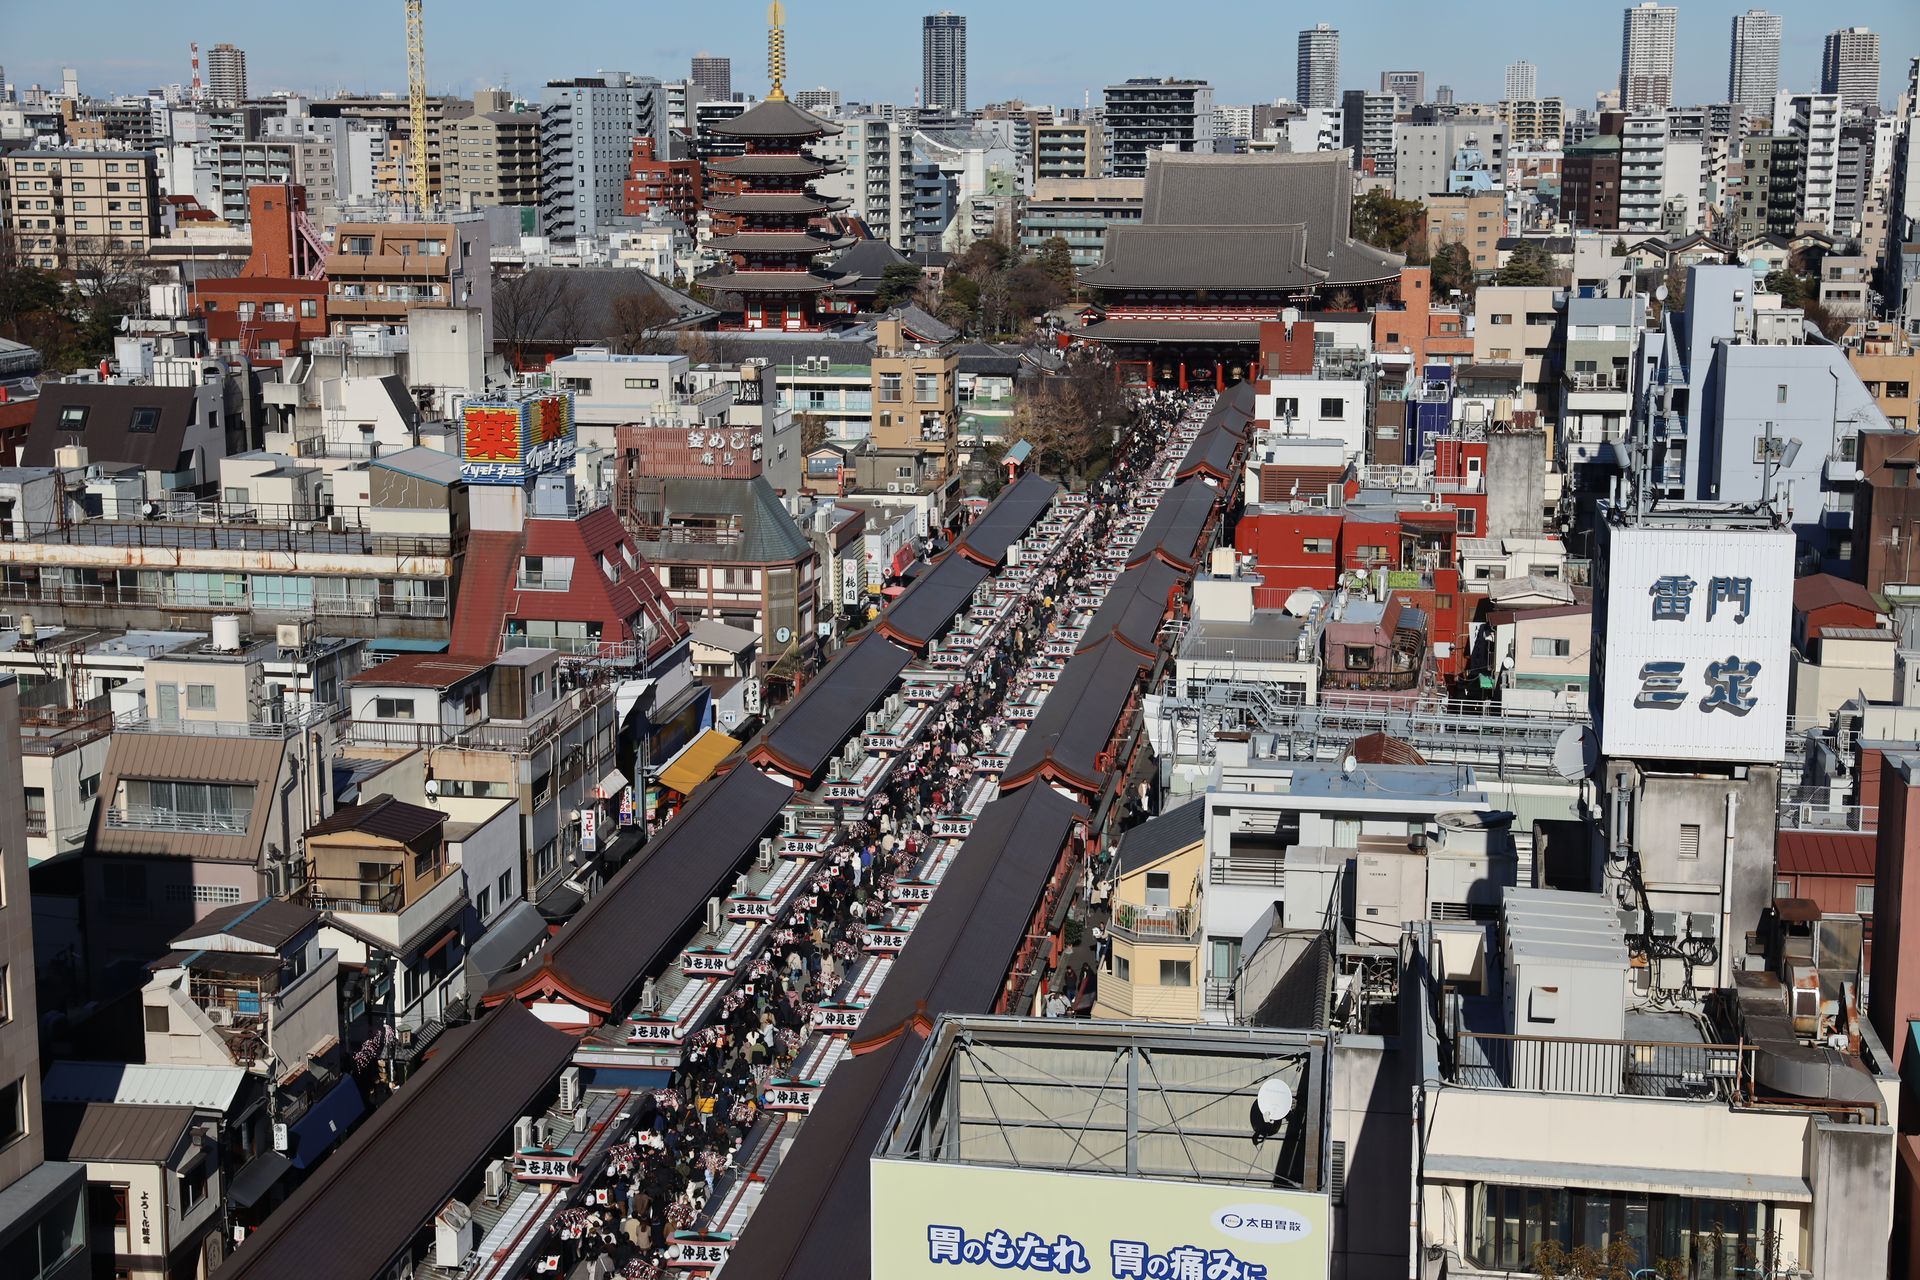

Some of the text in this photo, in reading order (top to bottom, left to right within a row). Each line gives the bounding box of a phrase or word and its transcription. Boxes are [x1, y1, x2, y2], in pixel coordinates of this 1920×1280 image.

[465, 410, 518, 460] 薬
[459, 463, 525, 479] マツモトキヨシ
[1648, 575, 1753, 620] 雷門
[1636, 655, 1763, 714] 三定
[1246, 1217, 1302, 1232] 太田胃散
[928, 1224, 1091, 1274] 胃のもたれ
[1110, 1239, 1268, 1280] 胃の痛みに
